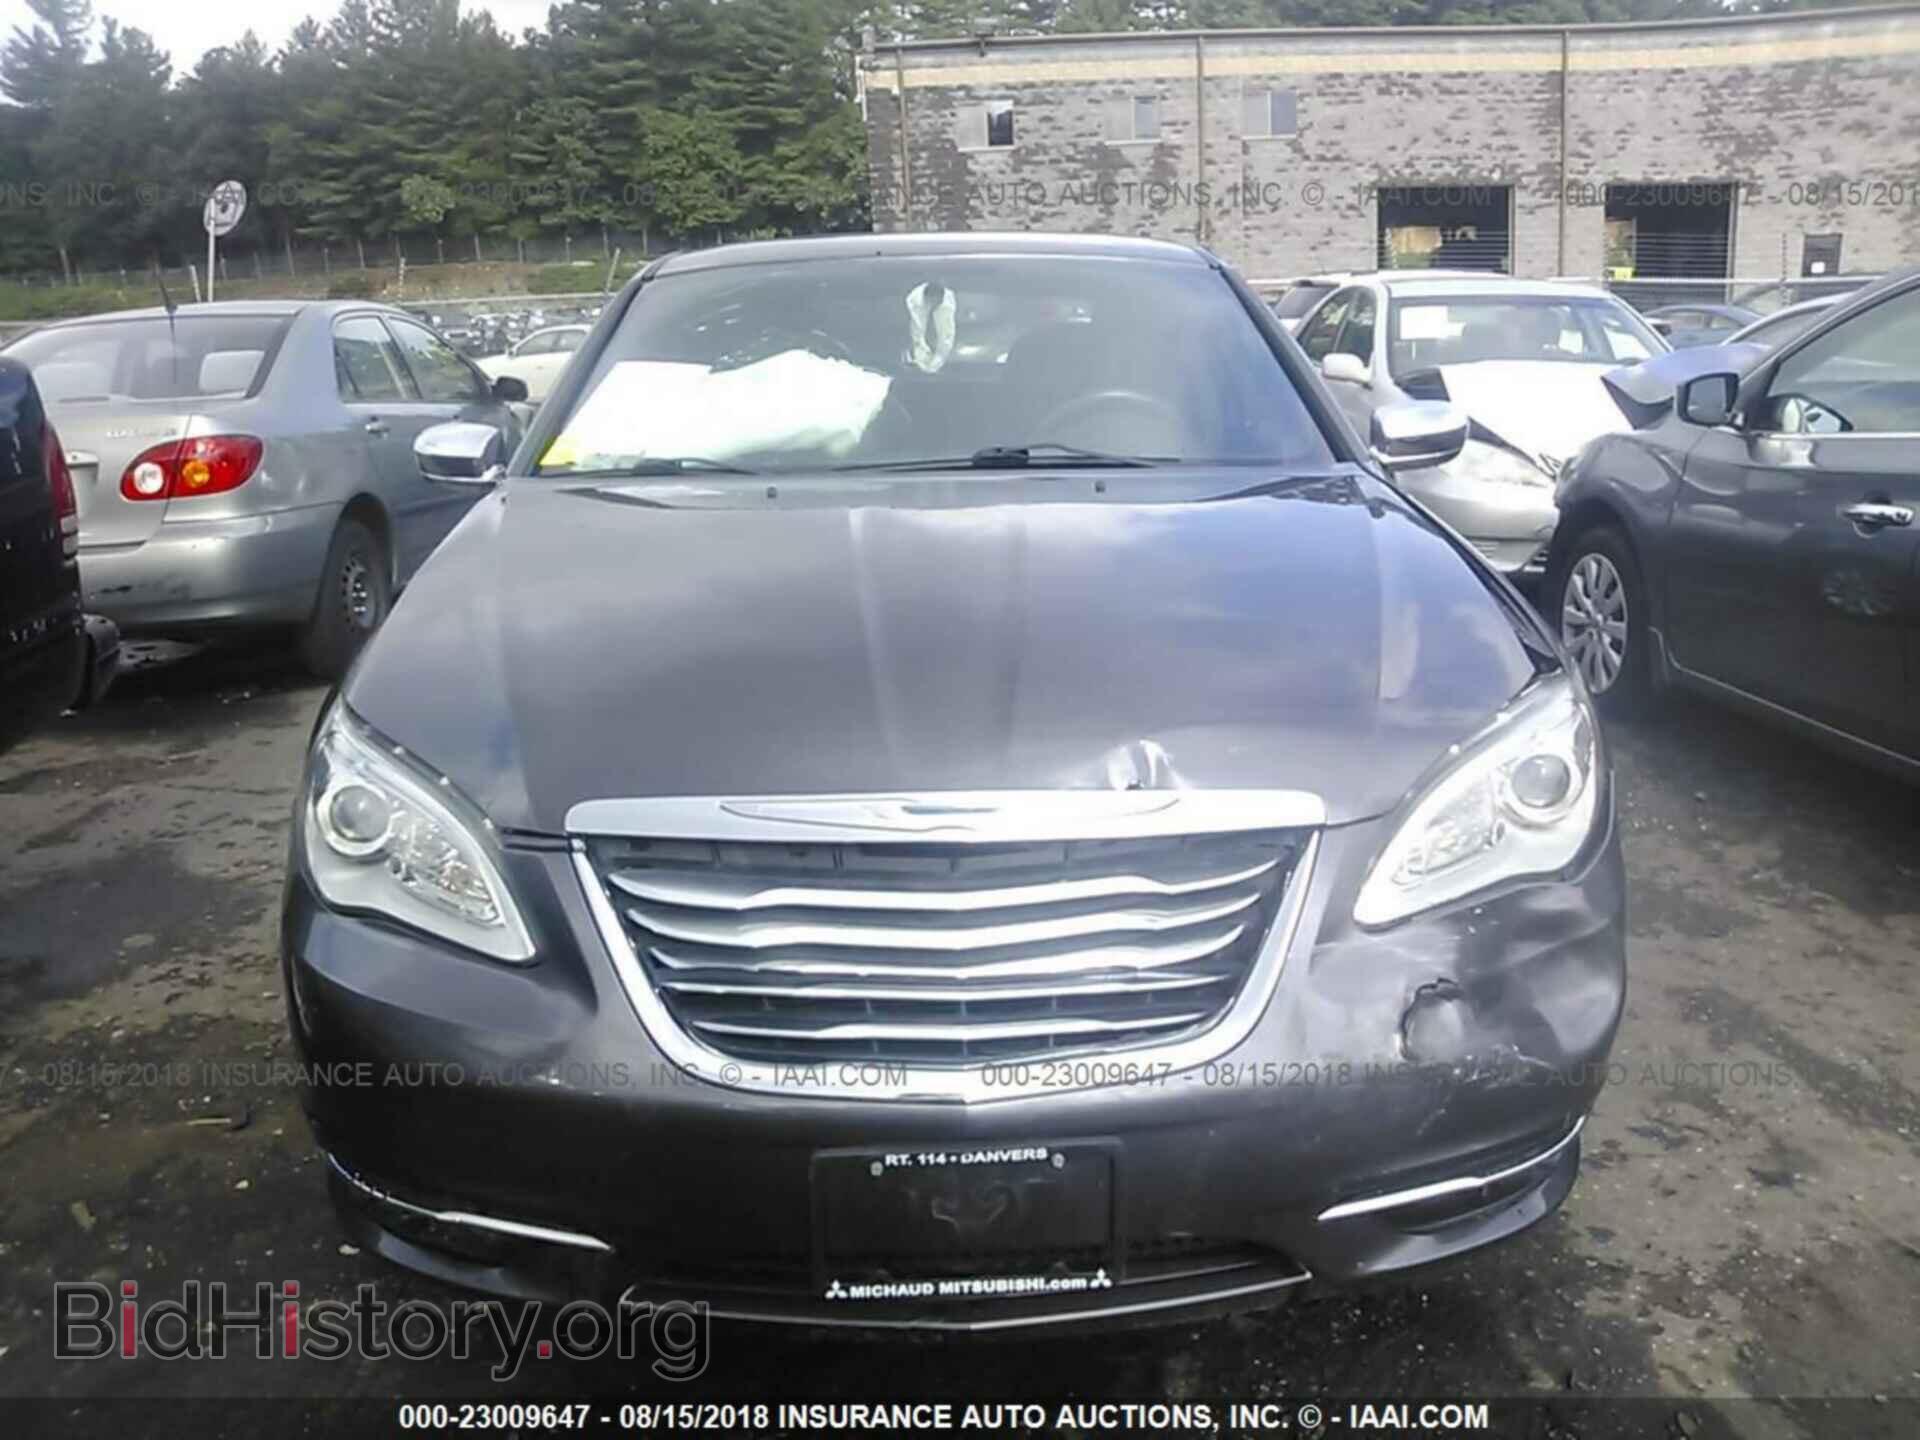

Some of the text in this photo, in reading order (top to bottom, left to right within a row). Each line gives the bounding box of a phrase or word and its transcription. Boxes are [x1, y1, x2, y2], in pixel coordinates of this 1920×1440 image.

[884, 1147, 1049, 1167] RT. 114 DANVERS
[849, 1277, 1088, 1299] MICHAUD MITSUBISHI.com
